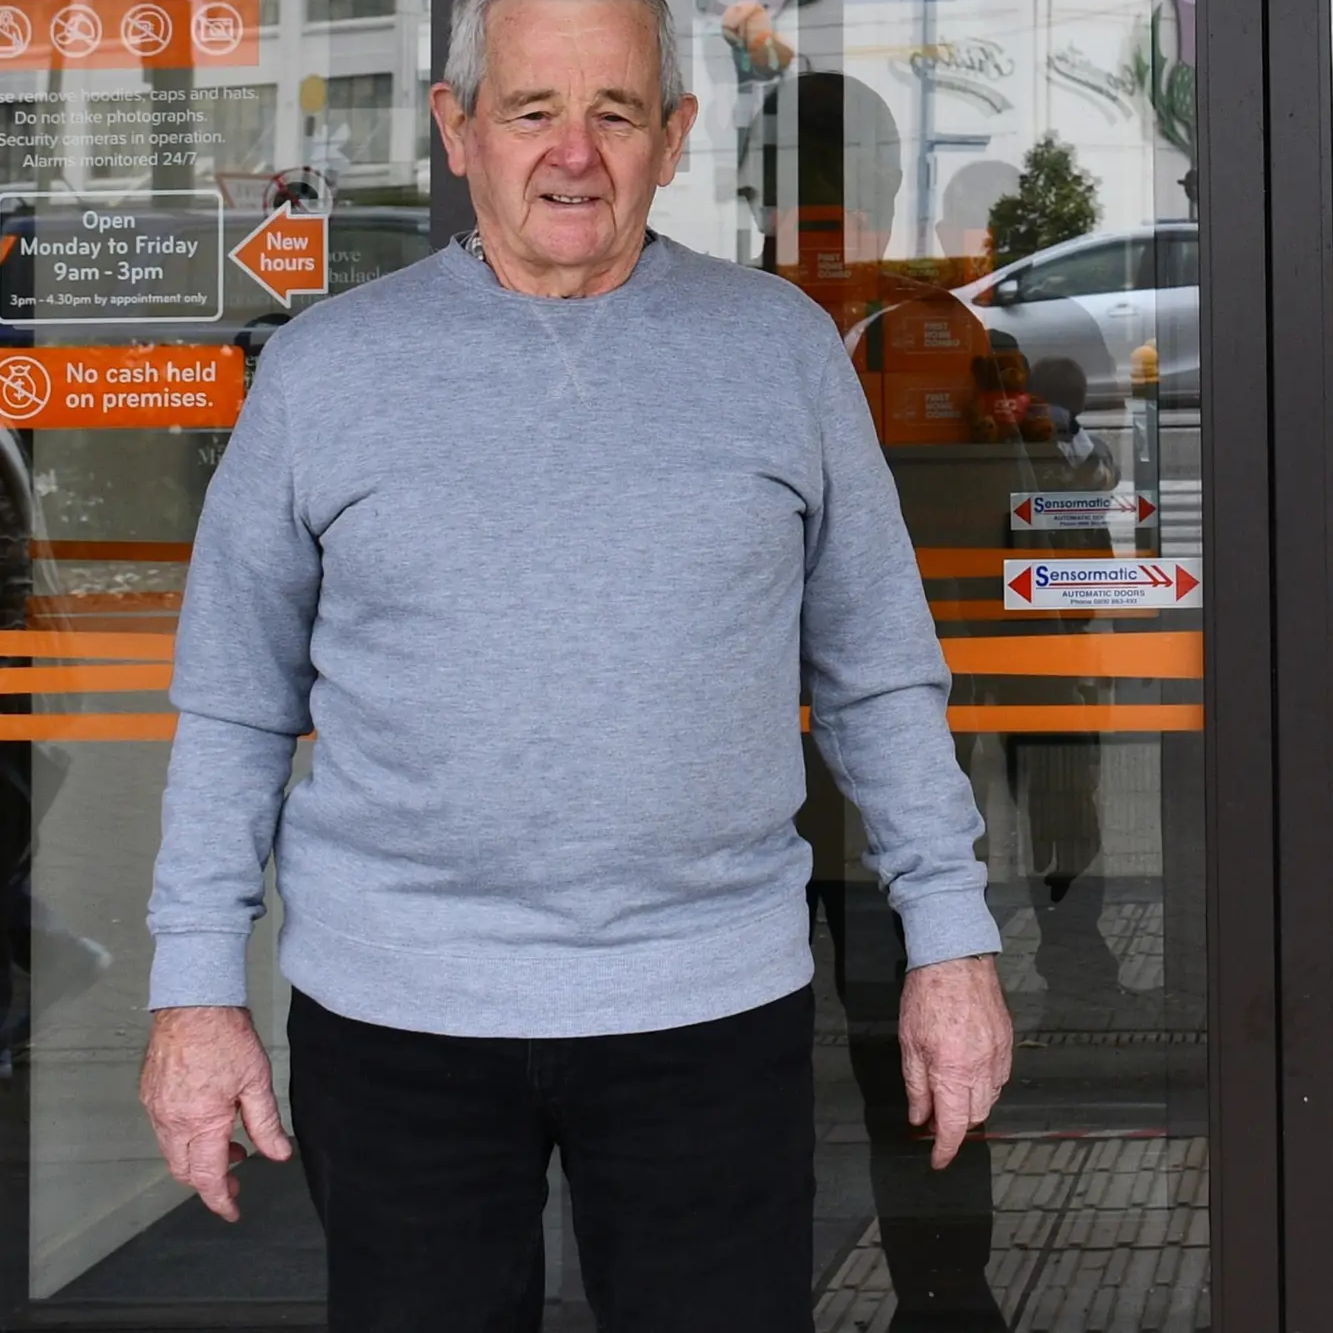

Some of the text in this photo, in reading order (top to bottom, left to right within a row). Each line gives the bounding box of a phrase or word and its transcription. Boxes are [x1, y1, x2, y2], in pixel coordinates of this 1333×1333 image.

[19, 91, 77, 103] remove
[81, 88, 146, 103] hoodies,
[150, 89, 186, 103] caps
[190, 87, 219, 100] and
[223, 86, 259, 100] hats.
[15, 108, 207, 126] Do not take photographs.
[0, 131, 226, 149] Security cameras in operation.
[22, 154, 77, 167] Alarms
[81, 152, 158, 167] monitored
[83, 211, 135, 233] Open
[20, 236, 198, 259] Monday to Friday
[267, 232, 309, 251] New
[260, 253, 315, 271] hours
[54, 262, 99, 282] 9am
[117, 261, 163, 284] 3pm
[10, 294, 36, 307] 3pm
[46, 293, 91, 307] 4.30pm
[94, 294, 107, 306] by
[110, 293, 181, 307] appointment
[184, 292, 207, 306] only
[66, 362, 216, 383] No cash held
[66, 387, 214, 412] on premises.
[1034, 497, 1110, 513] Sensormatic
[1036, 566, 1138, 587] Sensormatic
[1062, 589, 1146, 598] AUTOMATIC DOORS
